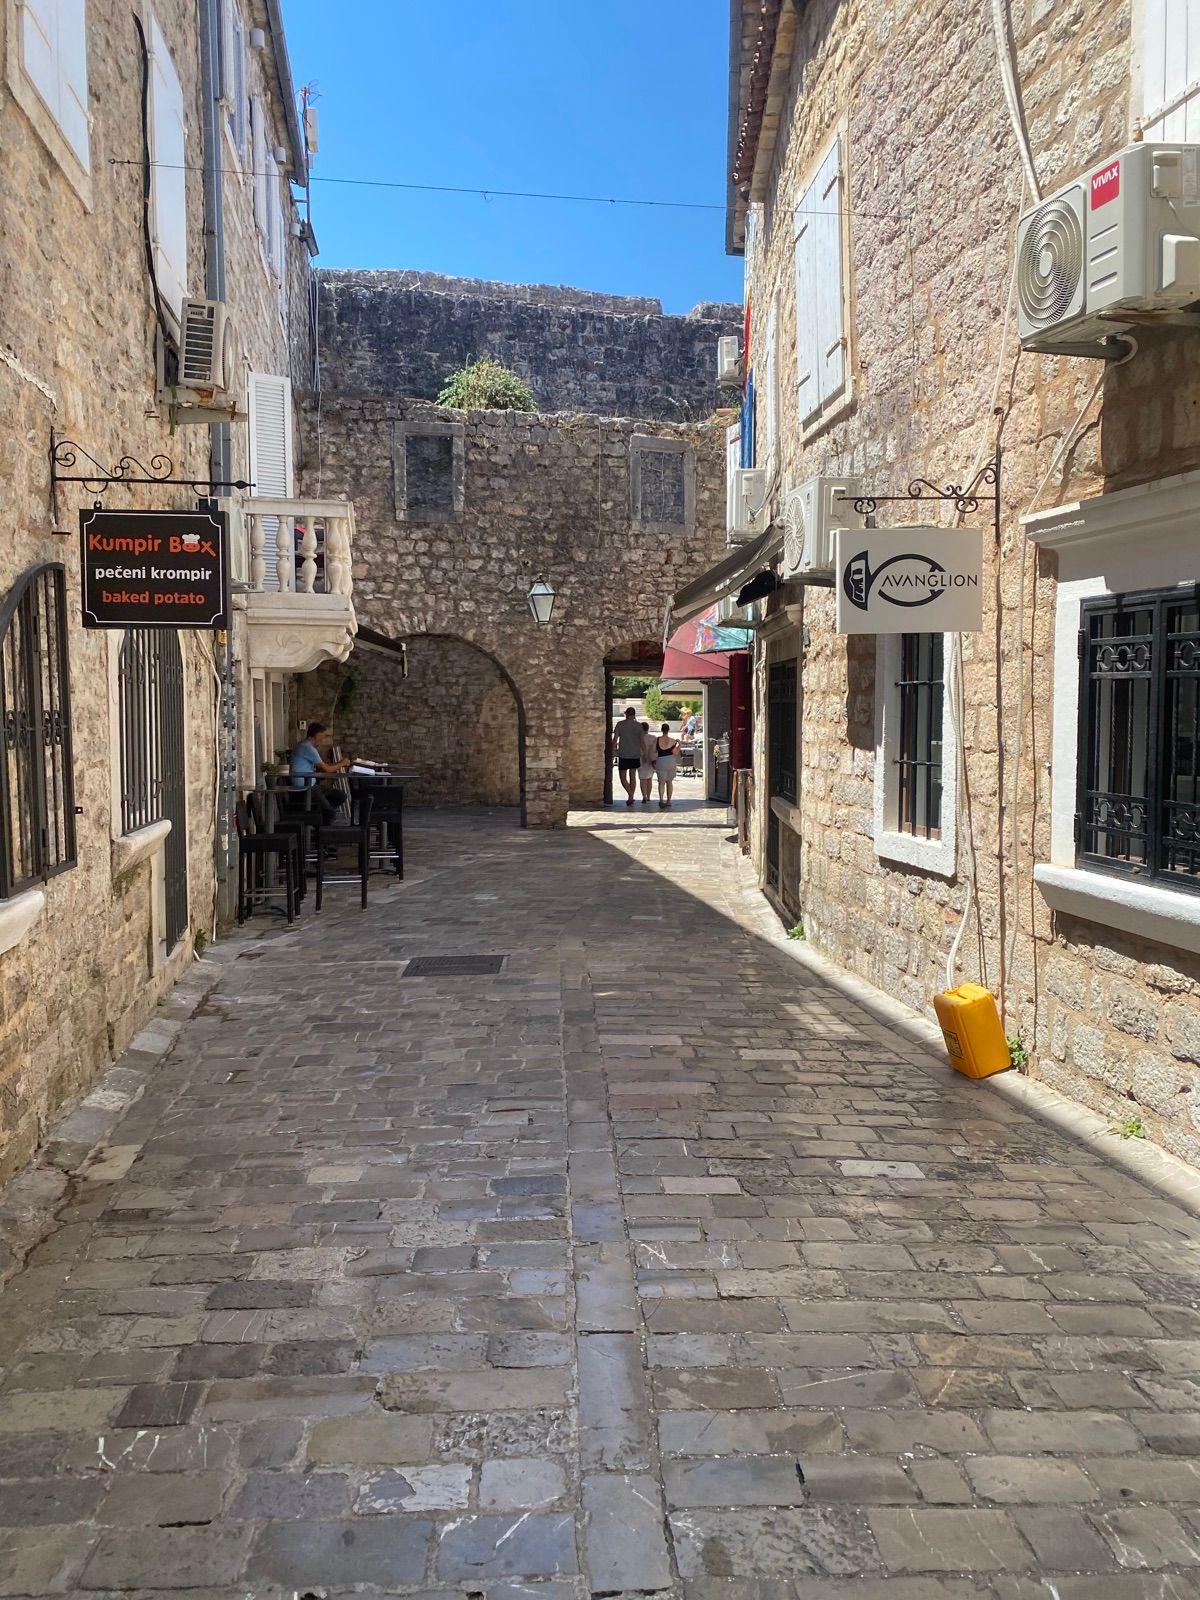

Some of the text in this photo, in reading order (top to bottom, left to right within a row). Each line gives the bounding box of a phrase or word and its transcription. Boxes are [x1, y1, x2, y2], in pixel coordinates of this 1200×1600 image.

[1092, 165, 1118, 190] VIVAX
[89, 534, 162, 556] Kumpir
[95, 565, 212, 582] pečeni krompir
[881, 574, 978, 588] AVANGLION
[102, 590, 205, 606] baked potato
